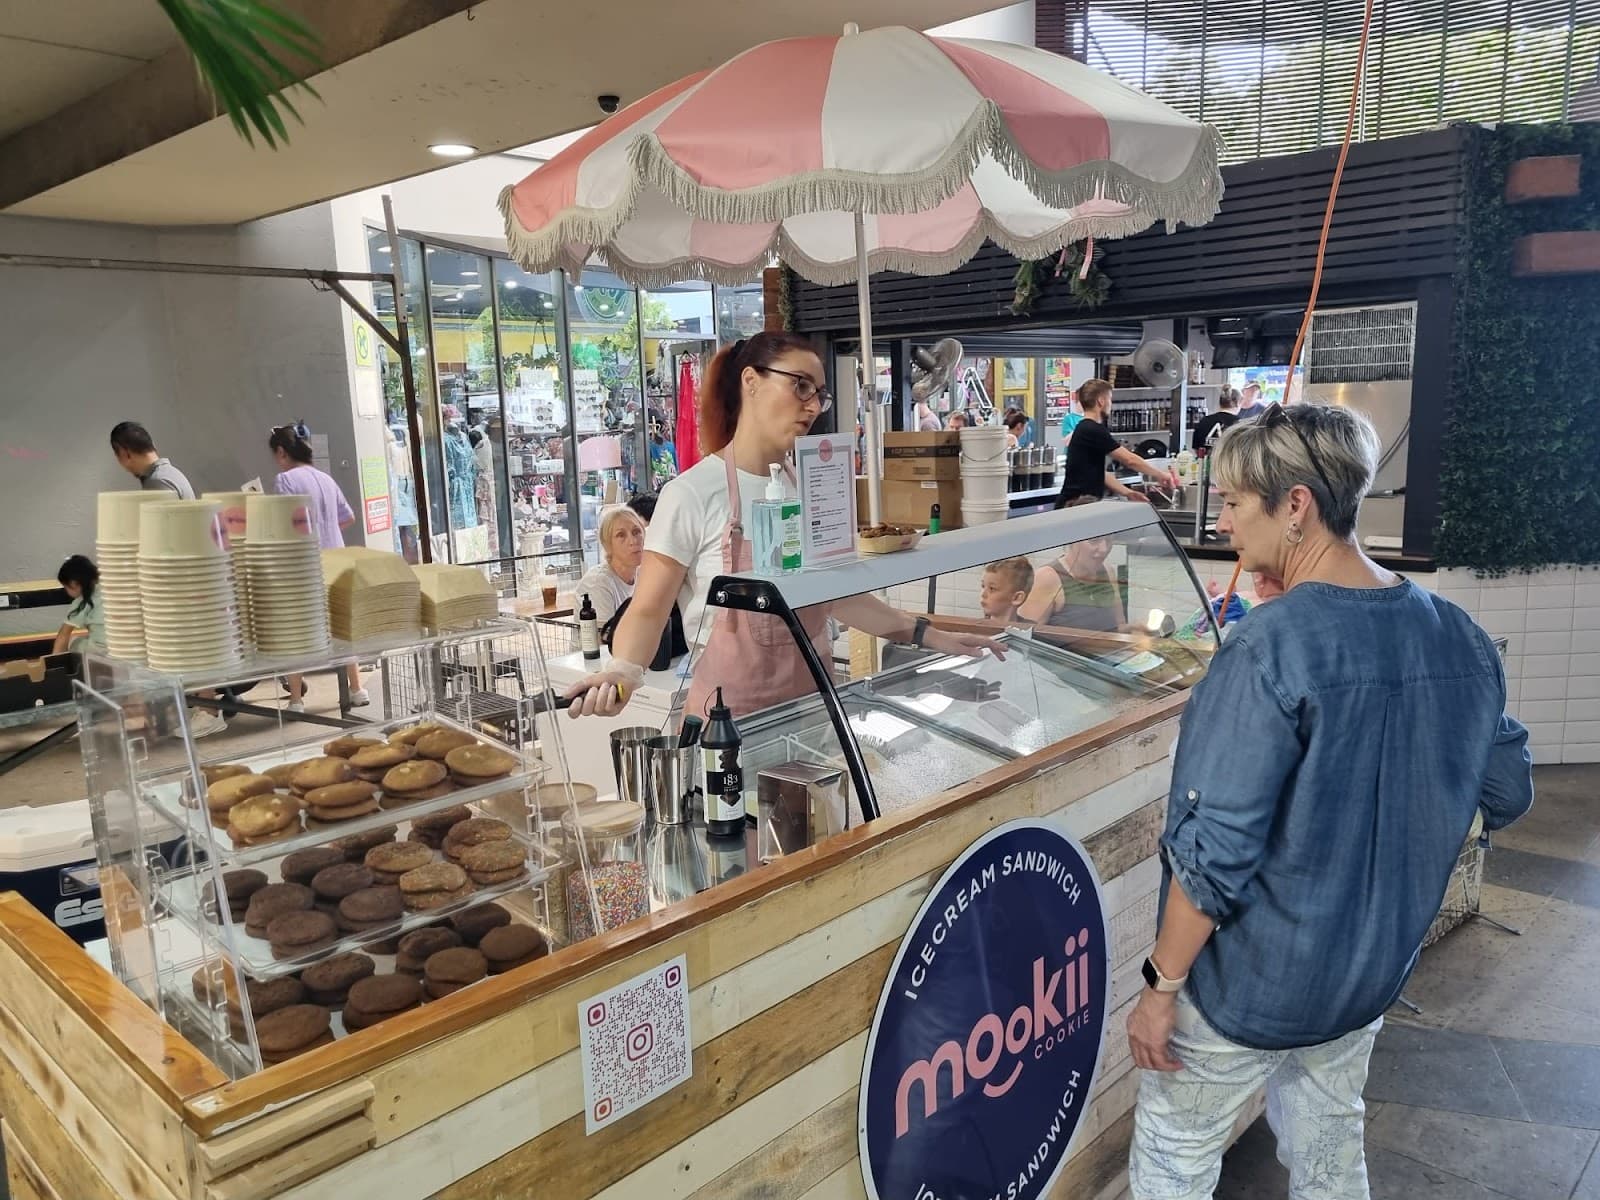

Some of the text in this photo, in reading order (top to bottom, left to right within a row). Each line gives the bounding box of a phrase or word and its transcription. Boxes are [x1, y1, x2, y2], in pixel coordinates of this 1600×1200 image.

[904, 850, 1081, 1000] ICECREAM SANDWICH
[895, 927, 1089, 1139] mookii
[1034, 1008, 1090, 1060] COOKIE
[1006, 1069, 1081, 1200] SANDWICH
